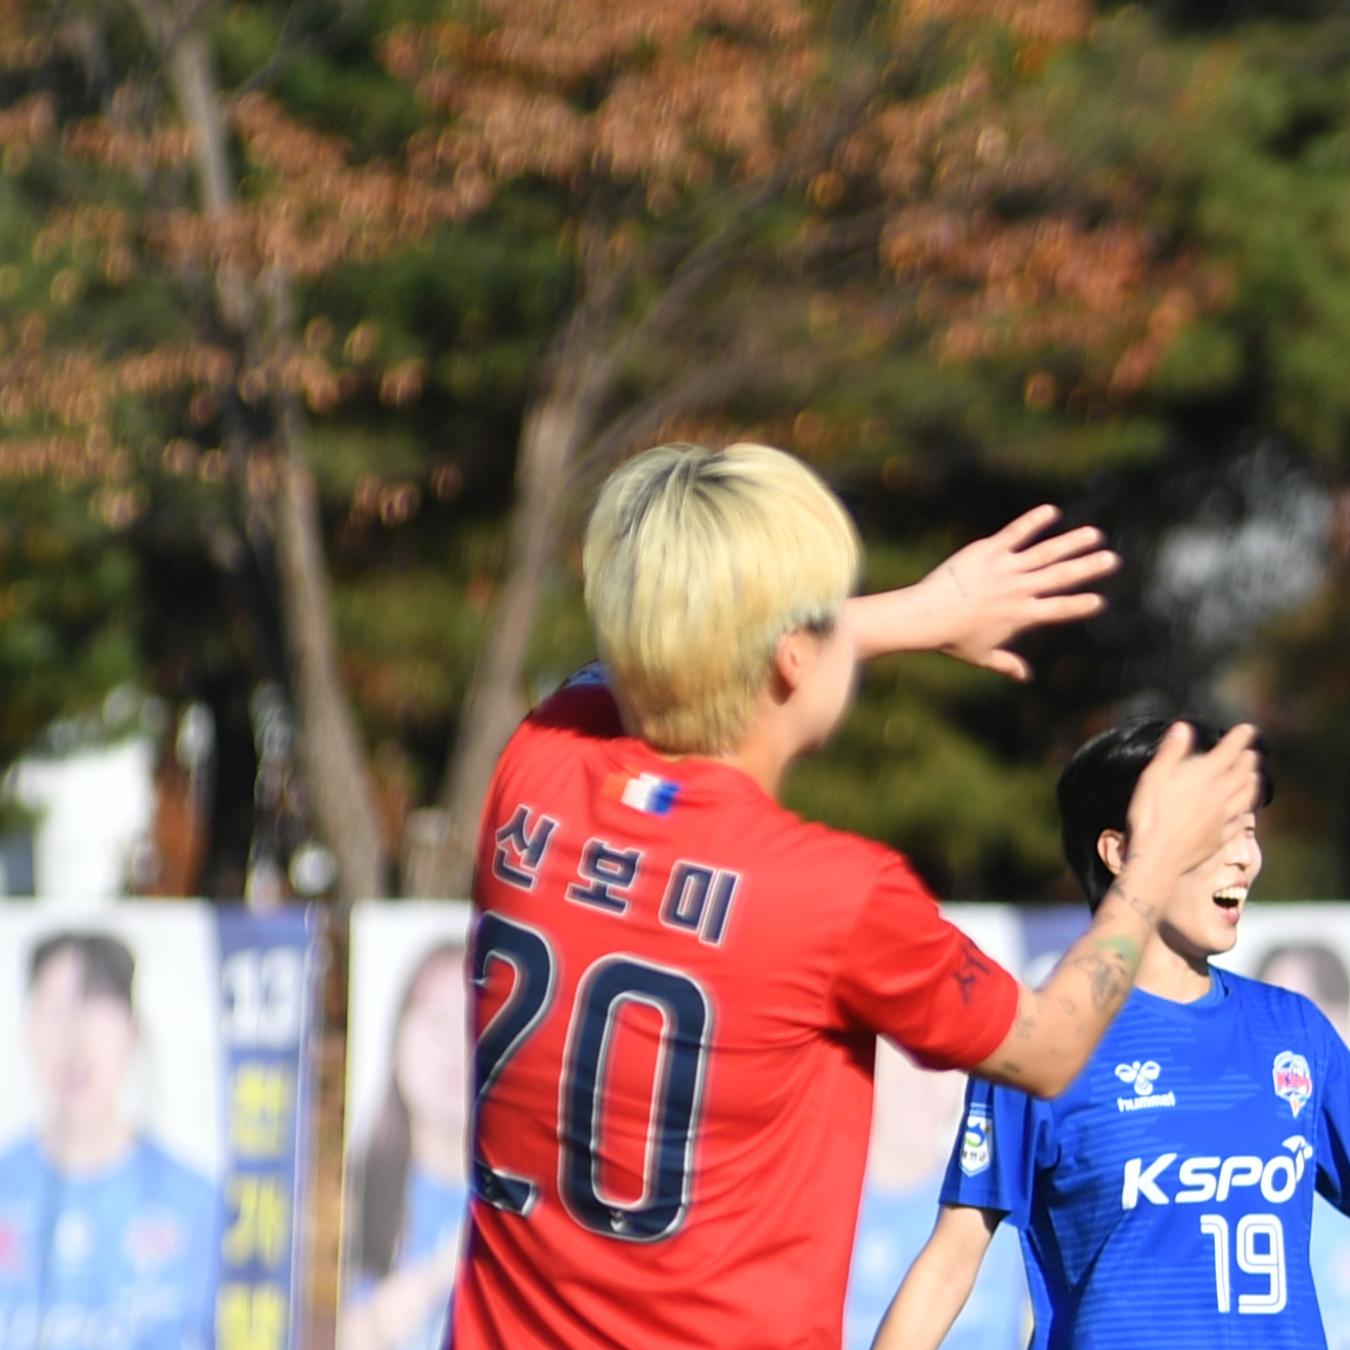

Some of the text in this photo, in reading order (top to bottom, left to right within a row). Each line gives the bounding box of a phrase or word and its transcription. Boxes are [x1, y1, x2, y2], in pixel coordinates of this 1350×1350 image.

[492, 804, 742, 948] 신보미
[469, 911, 713, 1243] 20
[1117, 1091, 1176, 1112] hummel
[1121, 1152, 1297, 1211] KSPO
[1200, 1213, 1287, 1314] 19
